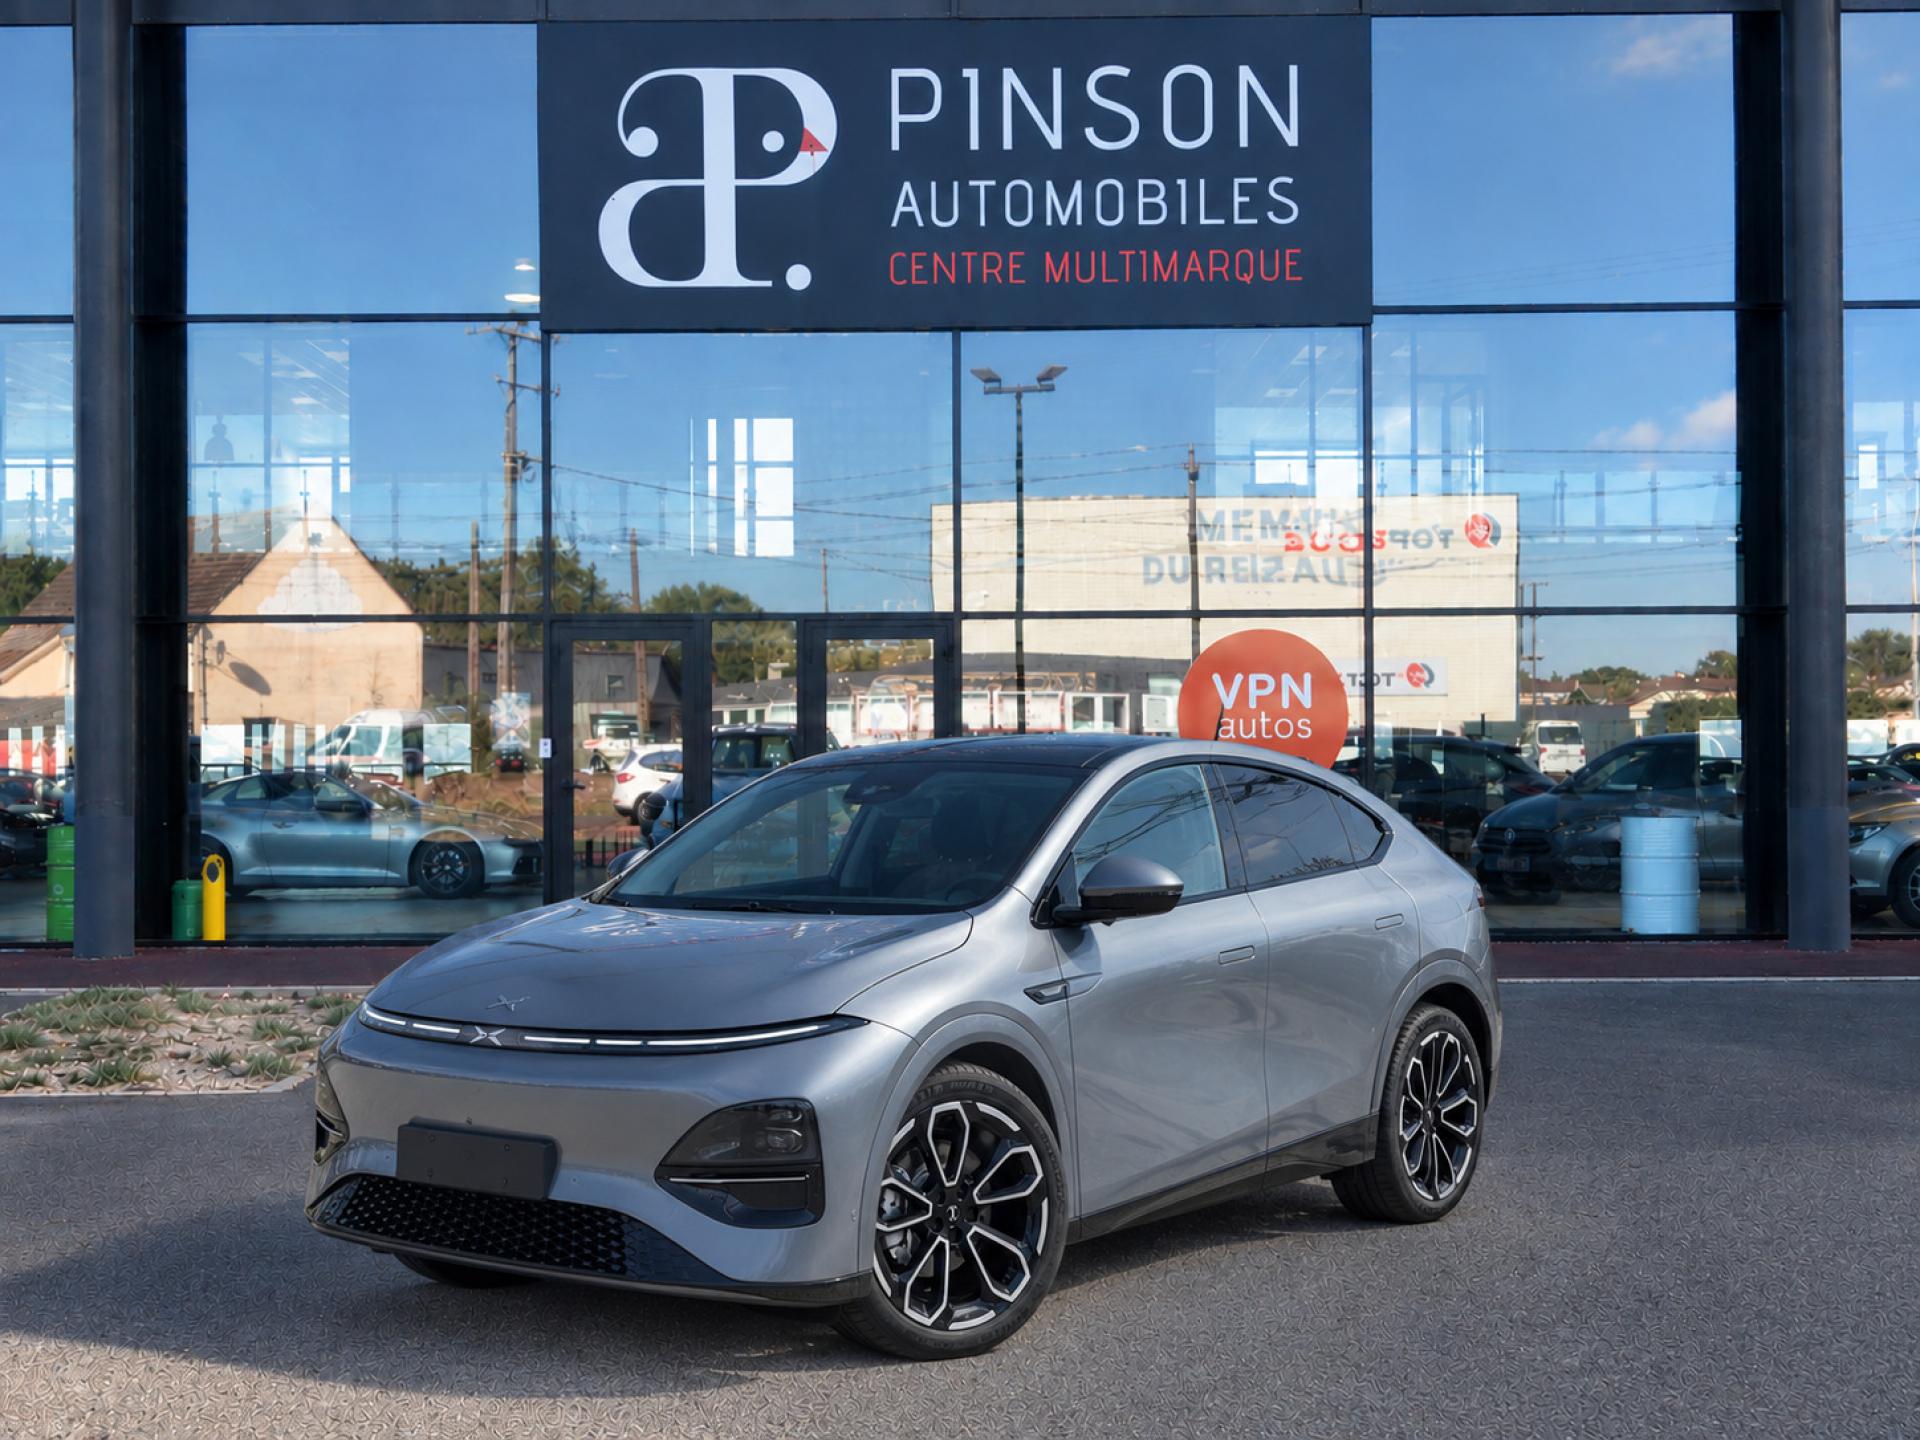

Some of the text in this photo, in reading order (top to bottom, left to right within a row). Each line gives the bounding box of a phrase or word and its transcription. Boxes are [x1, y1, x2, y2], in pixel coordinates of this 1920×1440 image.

[890, 63, 1299, 152] PINSON
[890, 175, 1299, 228] AUTOMOBILES
[888, 248, 1303, 285] CENTRE MULTIMARQUE
[1211, 671, 1312, 709] VPN
[1218, 711, 1312, 739] autos
